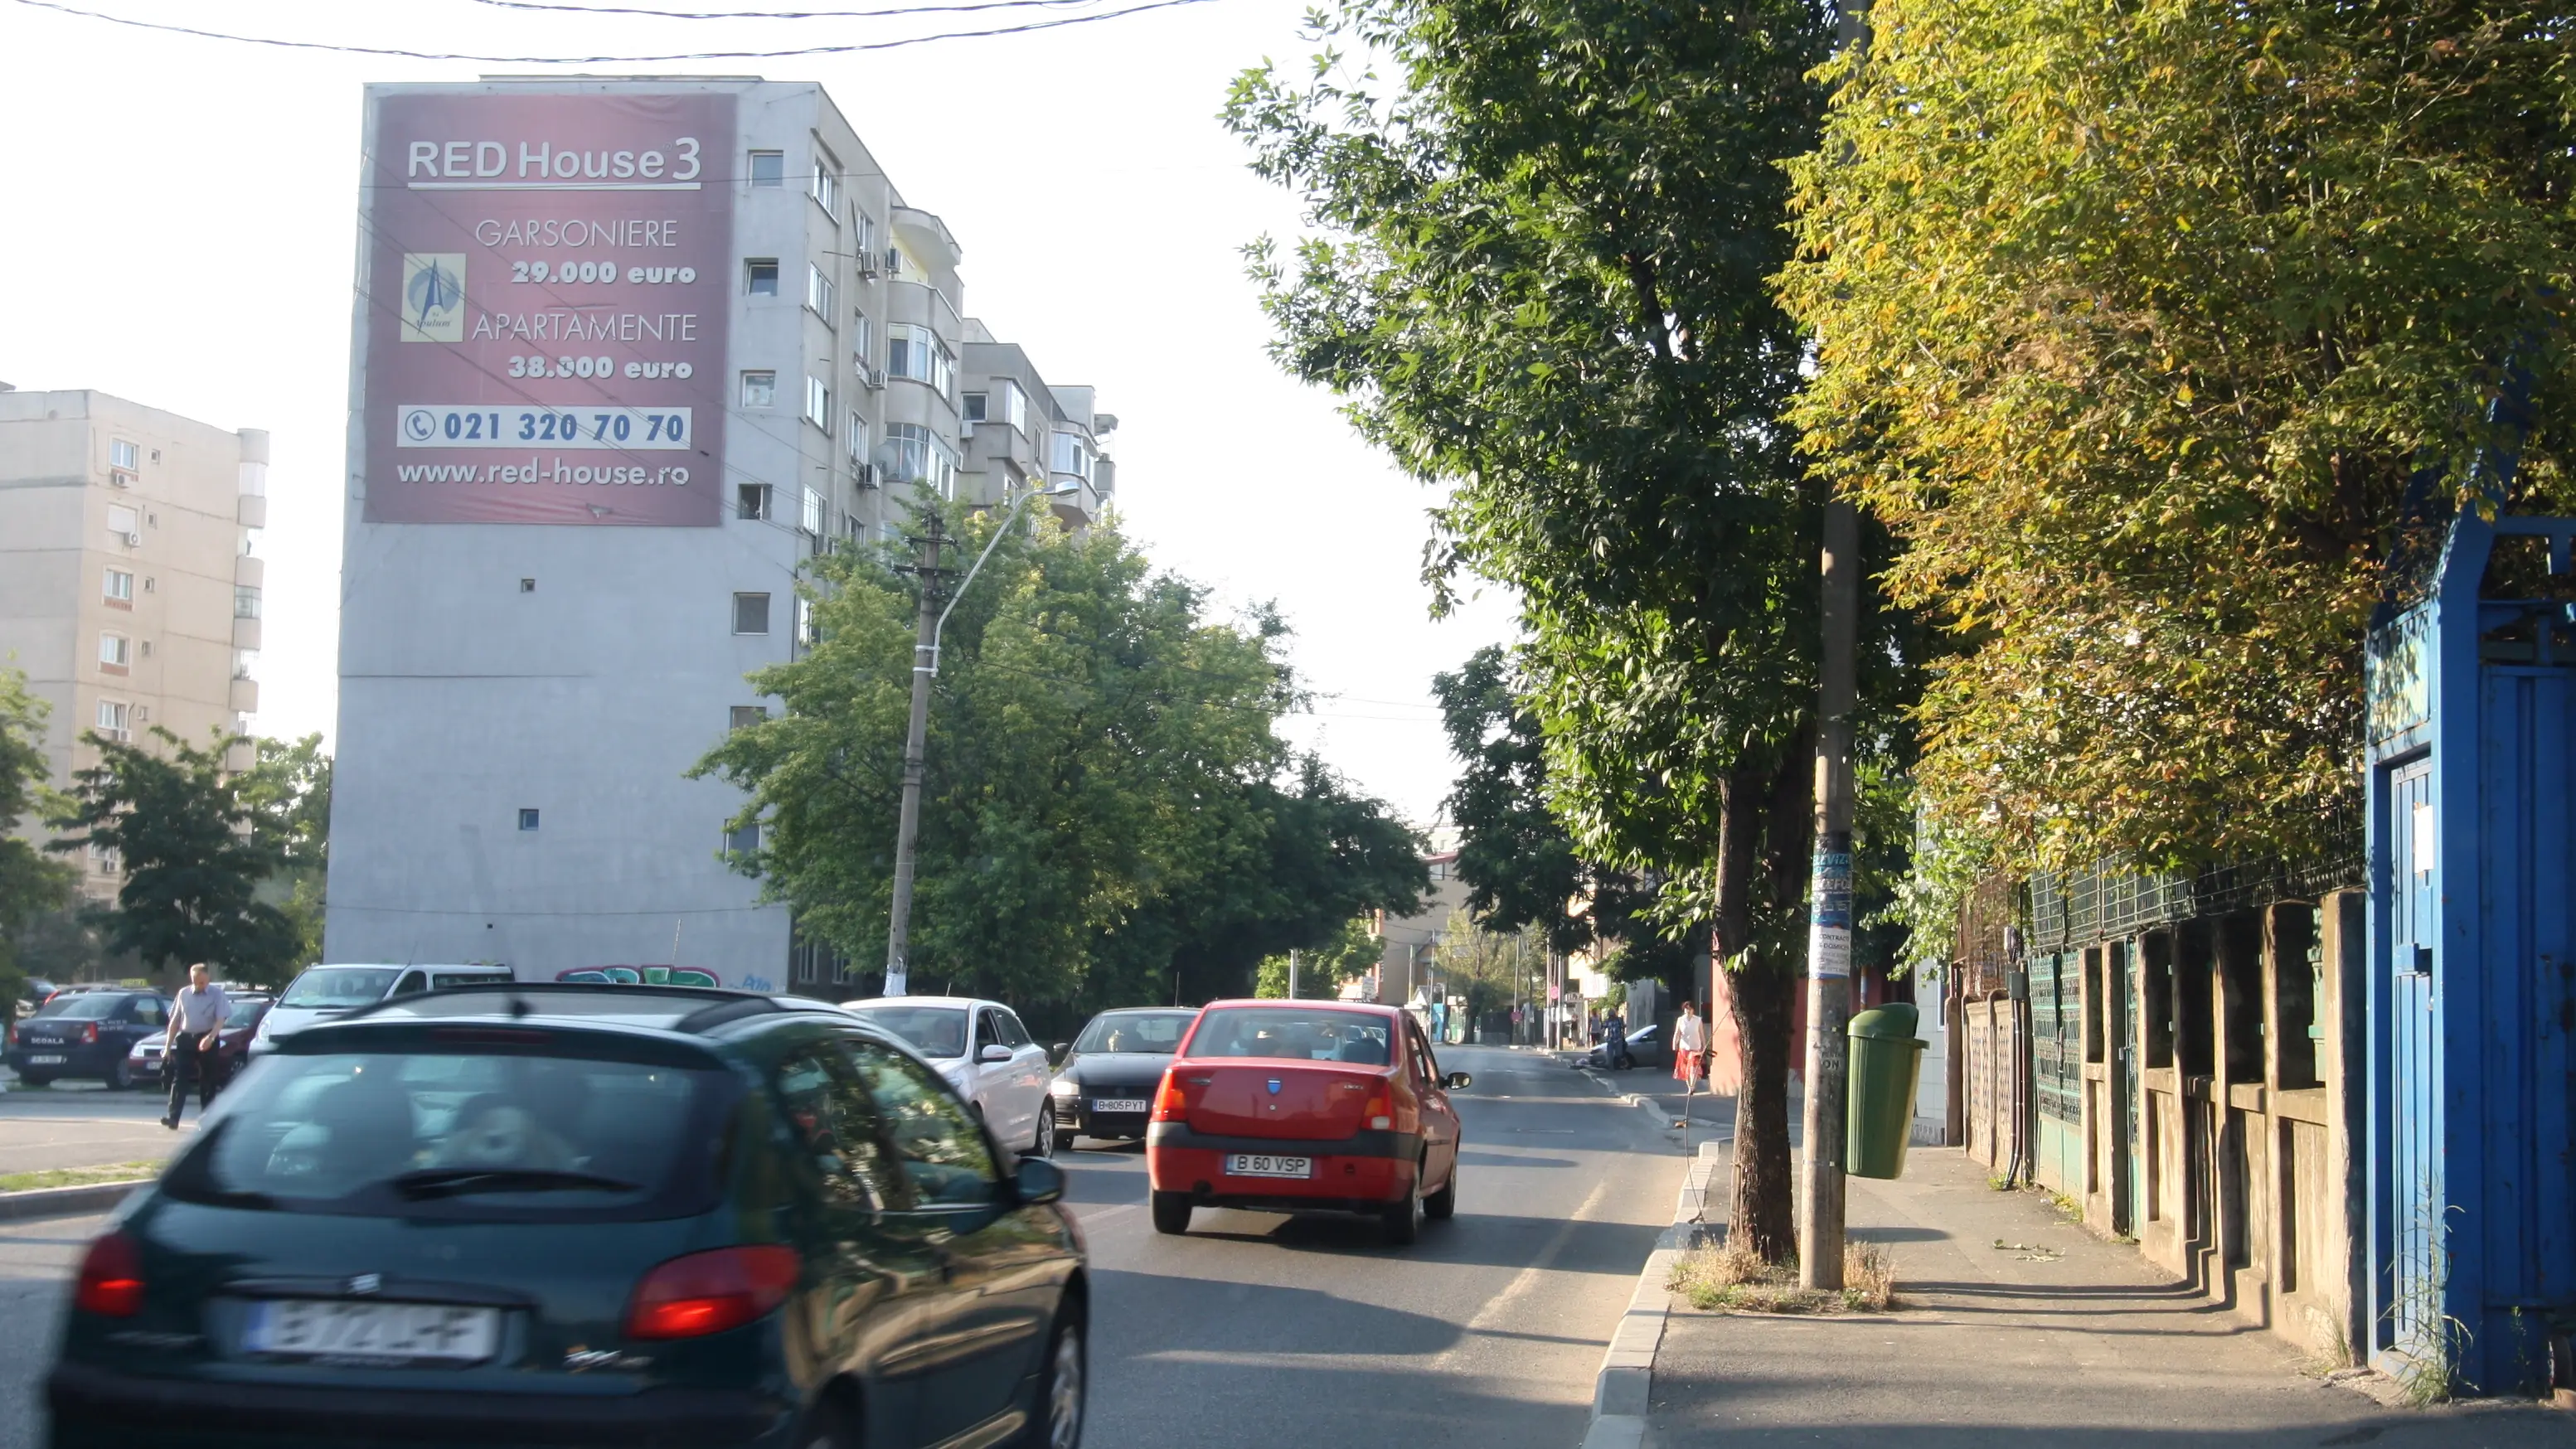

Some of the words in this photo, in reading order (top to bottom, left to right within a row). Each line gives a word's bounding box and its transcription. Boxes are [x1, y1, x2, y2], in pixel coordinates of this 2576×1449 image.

[409, 141, 507, 177] RED
[518, 141, 665, 179] House
[672, 137, 701, 181] 3
[475, 219, 678, 248] GARSONIERE
[511, 261, 618, 284] 29.000
[627, 266, 696, 284] euro
[471, 313, 697, 342] APARTAMENTE
[507, 356, 615, 378] 38.000
[623, 361, 693, 379] euro
[444, 413, 499, 439] 021
[518, 414, 578, 441] 320
[593, 414, 631, 441] 70
[646, 414, 684, 442] 70
[397, 458, 691, 486] www.red-house.ro
[1099, 1101, 1105, 1110] B
[1124, 1101, 1143, 1110] PYT
[1237, 1156, 1248, 1170] B
[1253, 1156, 1270, 1170] 60
[1275, 1157, 1306, 1172] VSP
